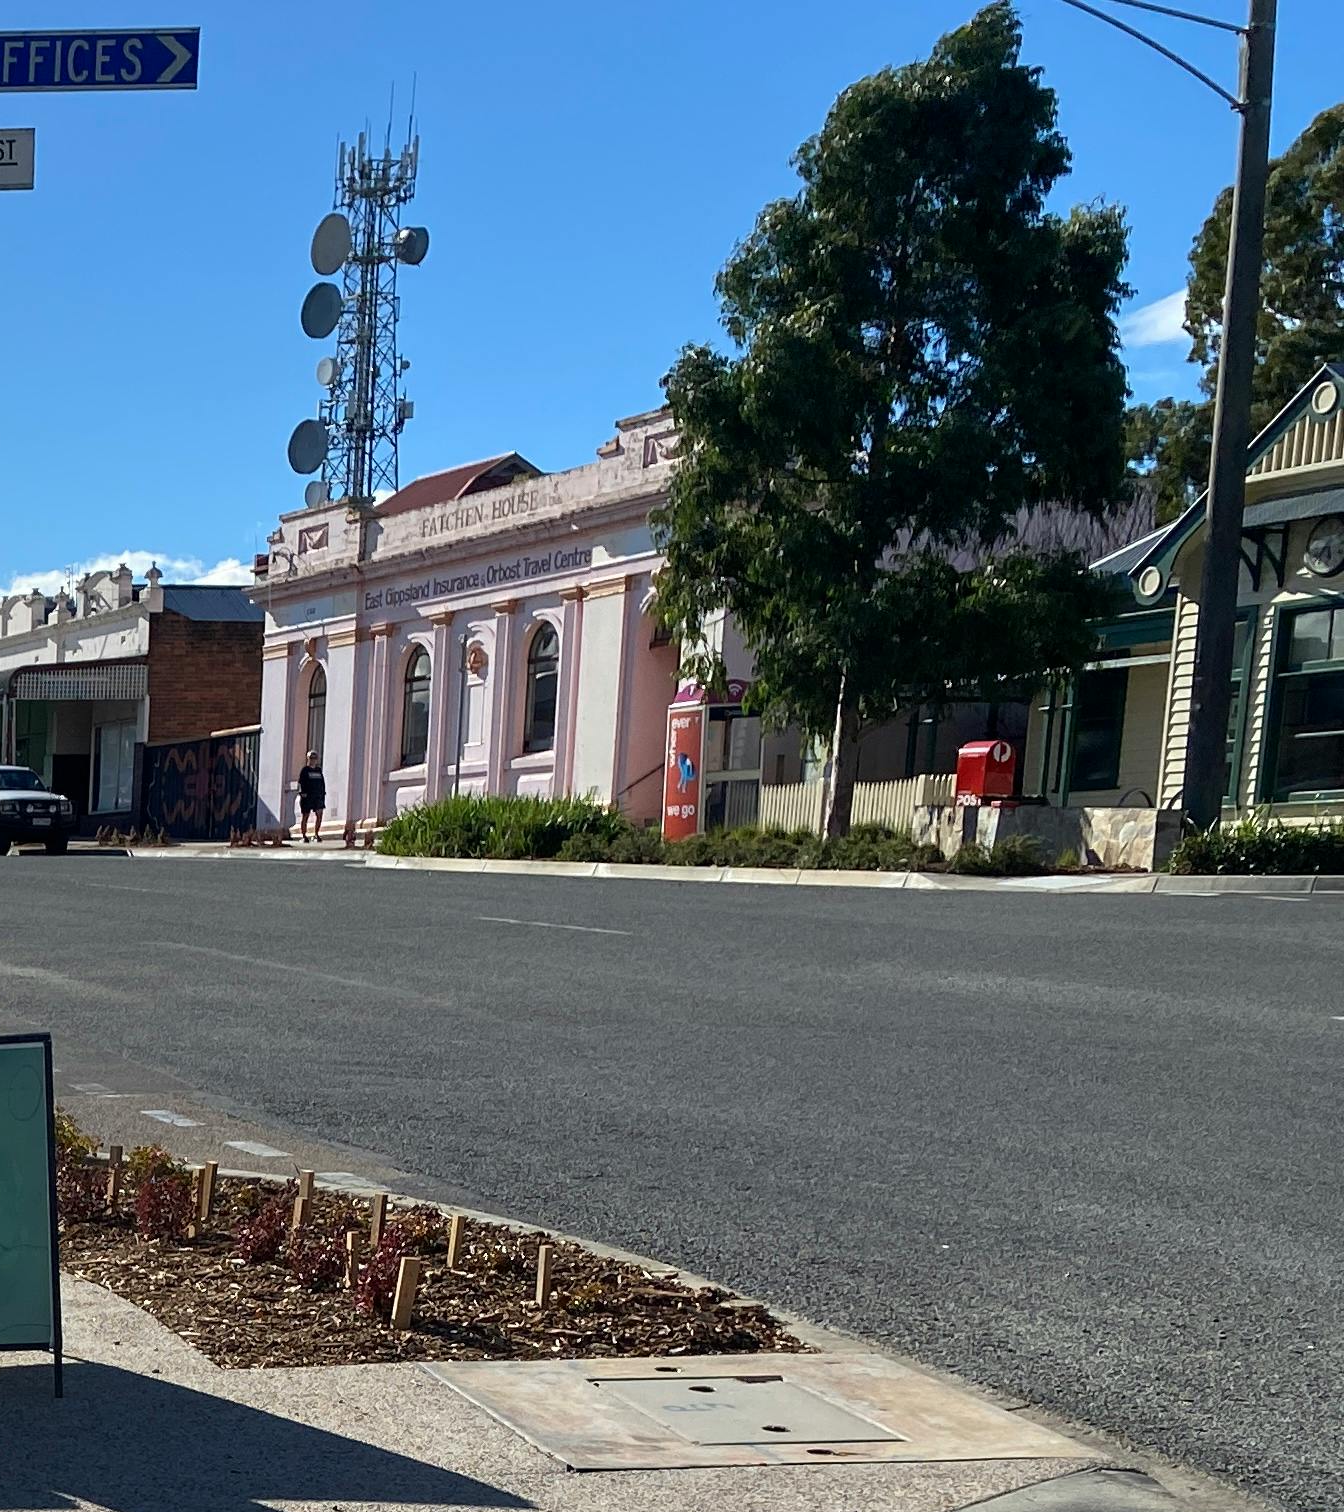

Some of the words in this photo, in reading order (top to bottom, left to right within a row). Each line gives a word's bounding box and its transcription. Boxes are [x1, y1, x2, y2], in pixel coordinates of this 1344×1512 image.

[422, 504, 484, 538] FATCHEN
[492, 490, 539, 521] HOUSE
[365, 593, 384, 610] East
[385, 579, 430, 608] Gippsland
[433, 572, 480, 596] Insurance
[486, 562, 521, 585] Orbost
[522, 553, 552, 577] Travel
[554, 547, 592, 569] Centre
[681, 804, 695, 819] go
